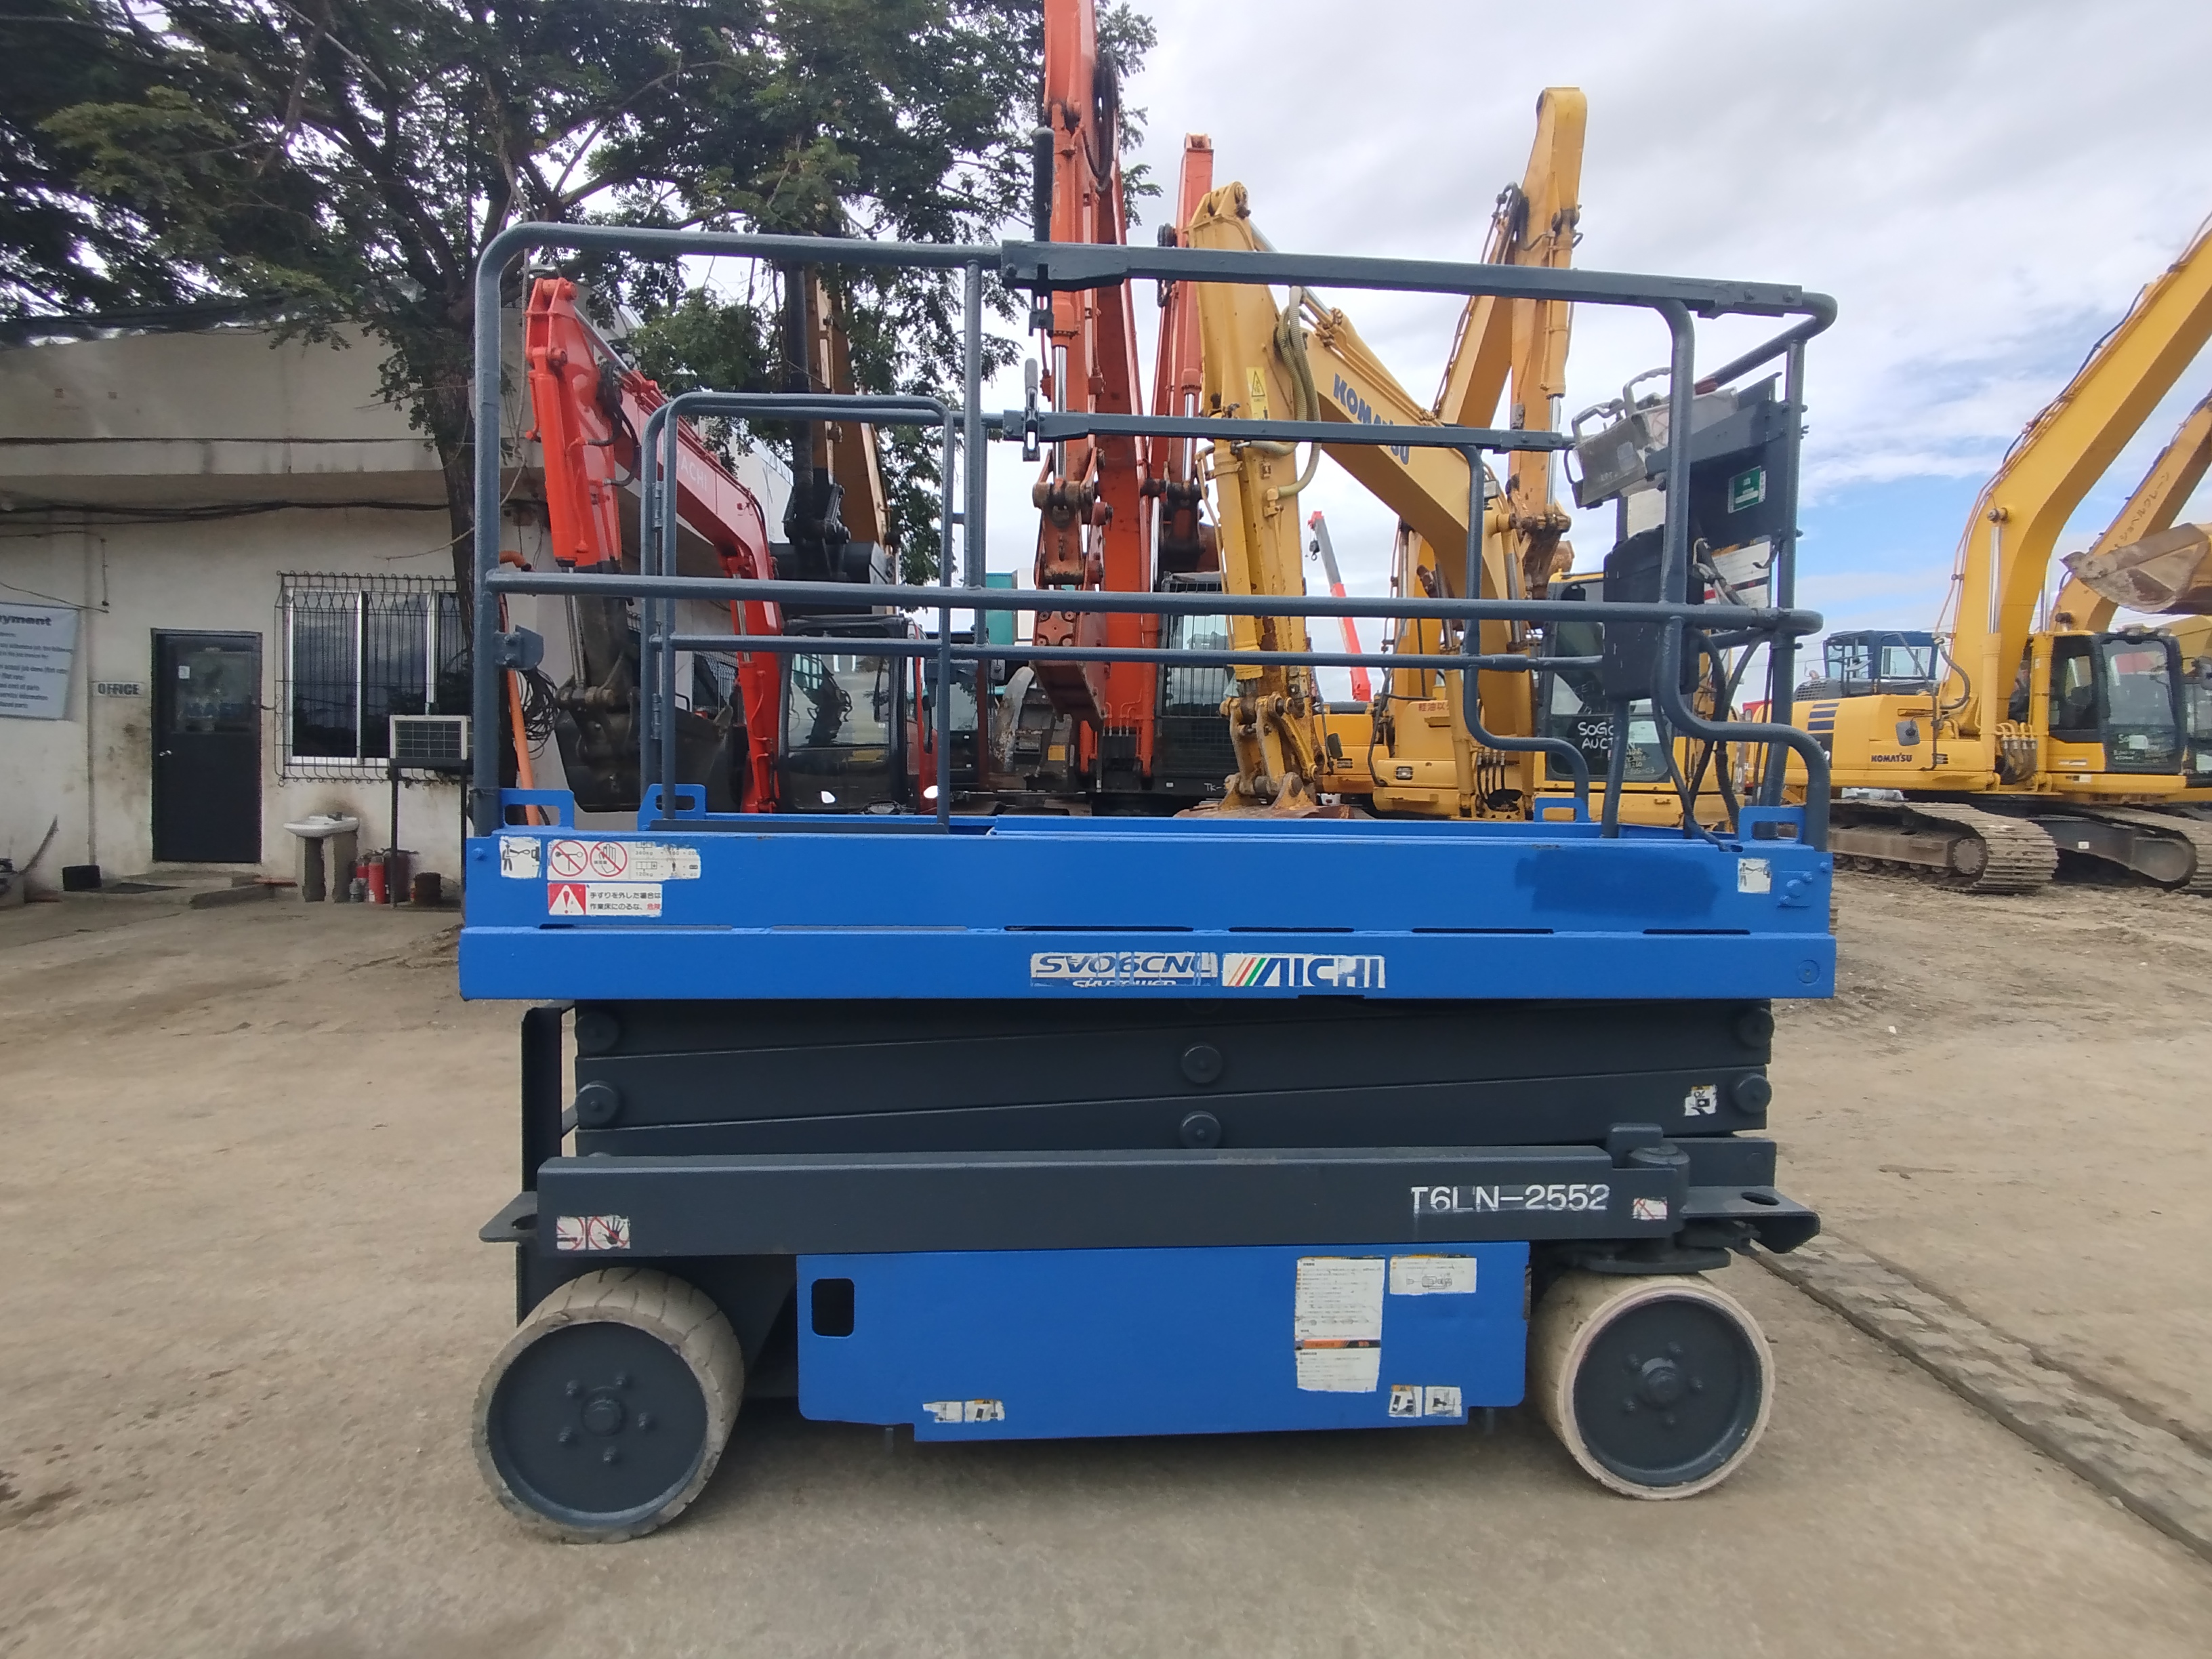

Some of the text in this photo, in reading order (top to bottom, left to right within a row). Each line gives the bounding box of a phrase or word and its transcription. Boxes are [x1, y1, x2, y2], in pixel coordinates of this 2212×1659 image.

[1333, 373, 1410, 466] KOMU
[0, 615, 52, 626] yment
[98, 683, 140, 695] OFFICE
[1871, 752, 1912, 762] KOMATSU
[1253, 958, 1380, 987] AICHI
[1410, 1184, 1611, 1214] T6LN-2552
